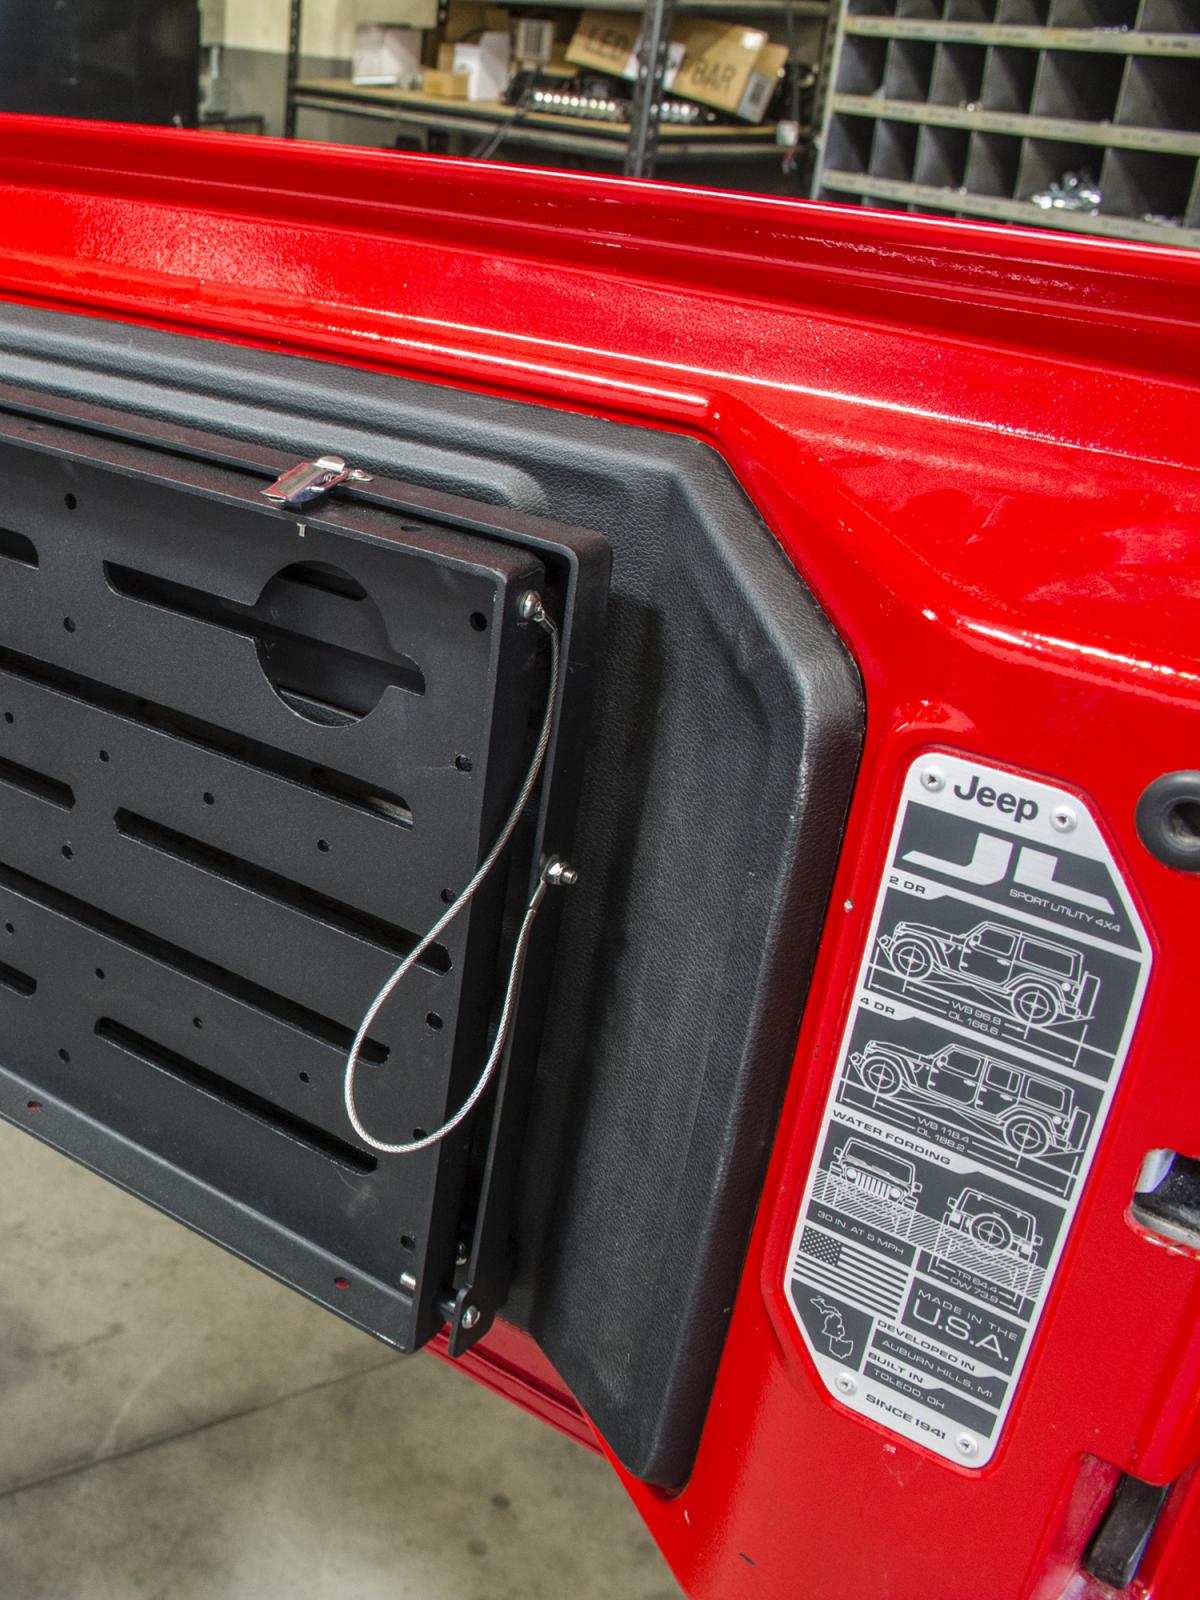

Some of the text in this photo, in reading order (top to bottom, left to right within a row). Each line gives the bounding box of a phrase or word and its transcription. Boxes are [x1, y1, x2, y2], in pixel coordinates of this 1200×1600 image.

[691, 60, 736, 92] BAR
[954, 775, 1039, 823] Jeep
[889, 875, 926, 895] 2 DR
[901, 832, 1115, 915] JL
[1009, 888, 1121, 933] SPORT UTILITY 4X4
[860, 997, 896, 1015] 4 DR
[951, 1000, 973, 1015] WB
[833, 1109, 951, 1165] WATER FORDING
[916, 1116, 938, 1130] WB
[817, 1210, 833, 1223] 30
[850, 1225, 865, 1238] AT
[866, 1232, 875, 1242] 5
[876, 1237, 905, 1256] MPH
[956, 1269, 972, 1282] TR
[913, 1299, 1009, 1362] U.S.A.
[918, 1289, 1018, 1342] MADE IN THE
[868, 1351, 924, 1384] BUILT IN
[877, 1319, 976, 1372] DEVELOPED IN
[873, 1369, 945, 1410] TOLEDO, OH
[881, 1339, 993, 1399] AUBURN HILLS, MI
[865, 1393, 946, 1440] SINCE 1941
